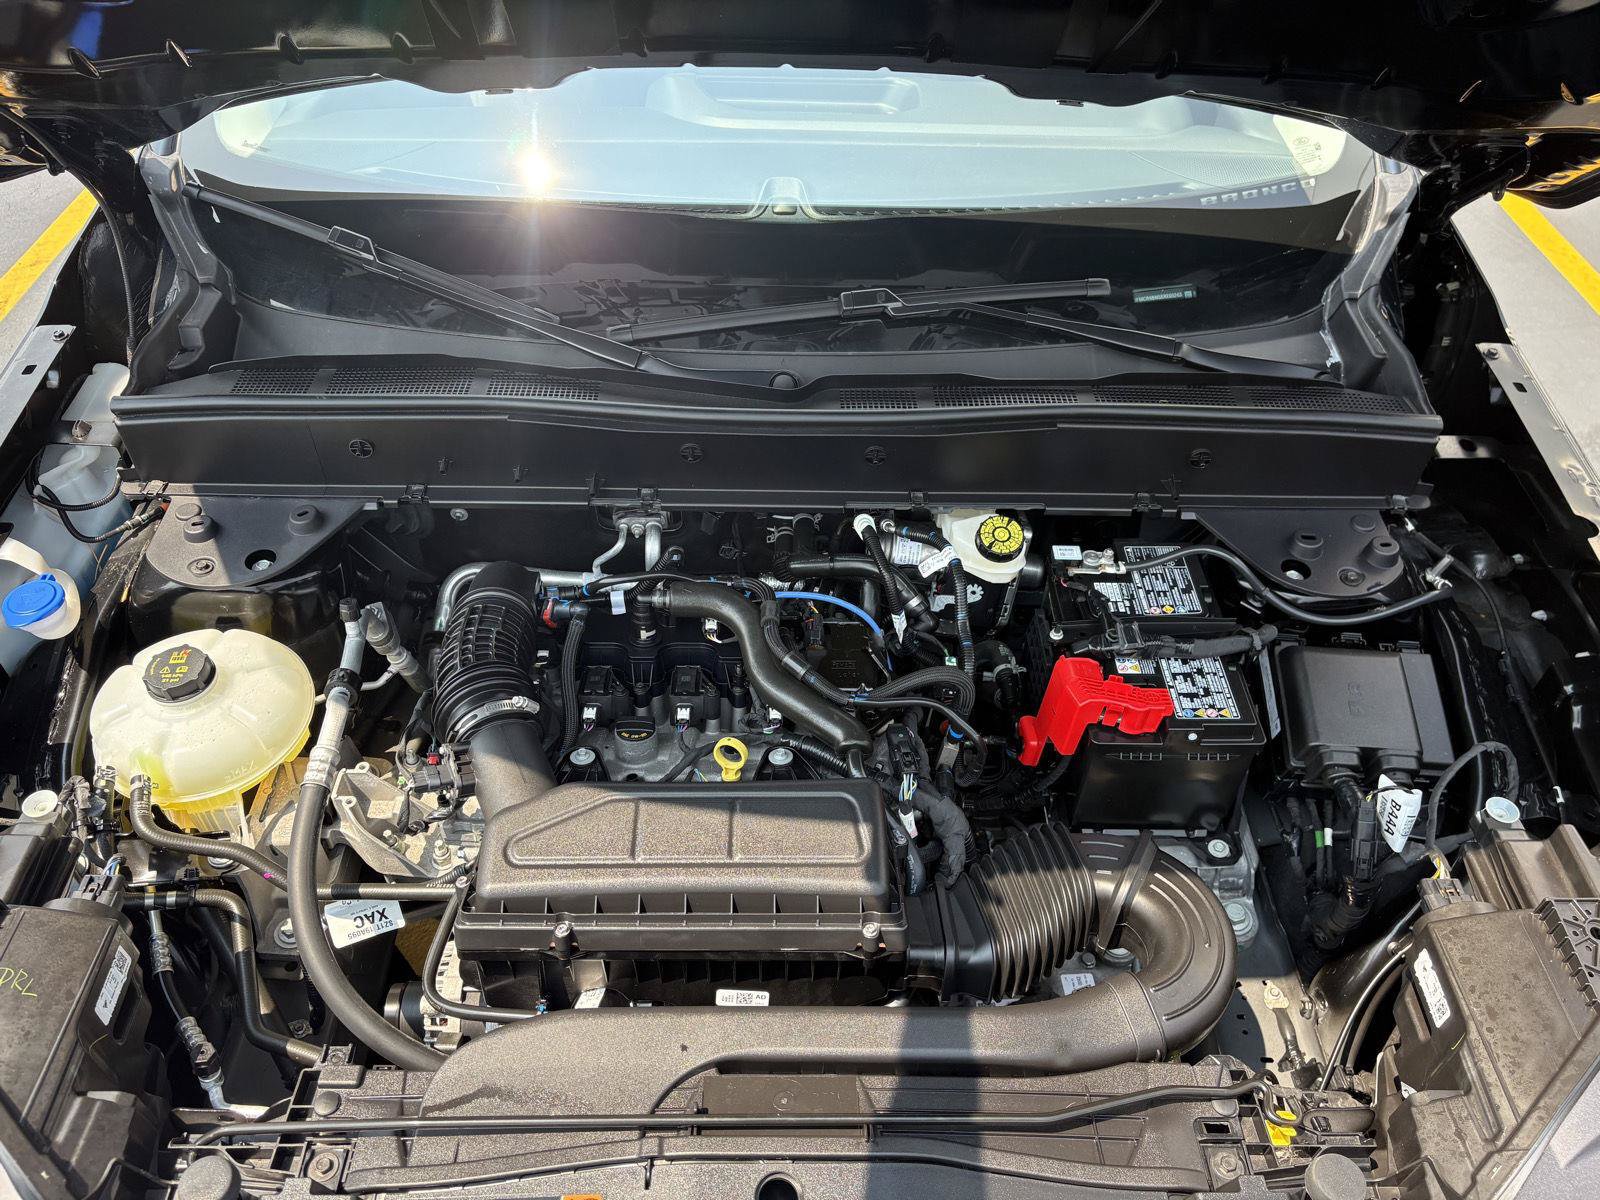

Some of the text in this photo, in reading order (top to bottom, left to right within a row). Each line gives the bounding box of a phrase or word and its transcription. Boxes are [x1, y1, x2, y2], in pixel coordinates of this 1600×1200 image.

[1200, 178, 1316, 206] BRONCO
[1384, 798, 1402, 837] BAAA
[353, 907, 390, 929] XAC
[0, 966, 38, 997] DRL
